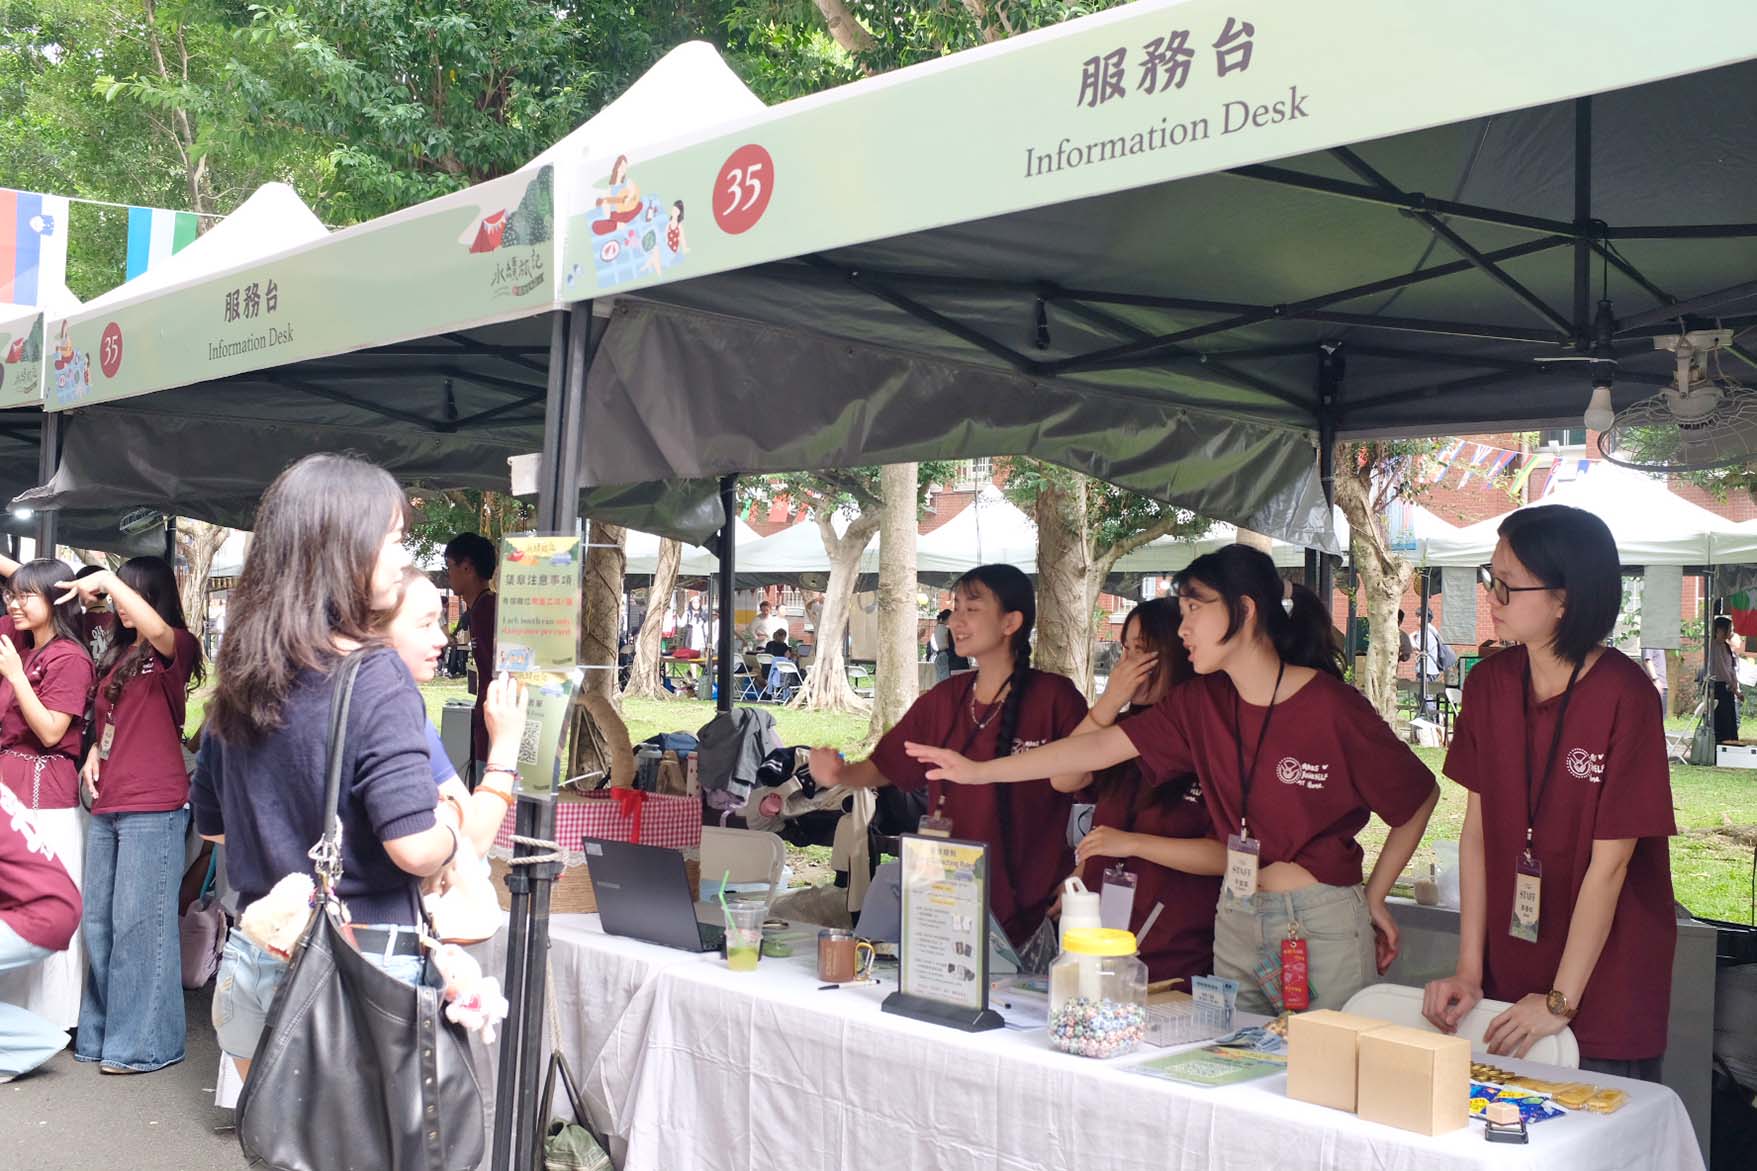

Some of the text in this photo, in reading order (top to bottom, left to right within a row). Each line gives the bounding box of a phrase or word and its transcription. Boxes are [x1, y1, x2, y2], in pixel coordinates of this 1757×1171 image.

[1077, 16, 1255, 108] 服務台
[1023, 85, 1310, 179] Information Desk
[722, 161, 763, 217] 35
[223, 279, 278, 323] 服務台
[104, 335, 119, 366] 35
[208, 321, 295, 361] Information Desk
